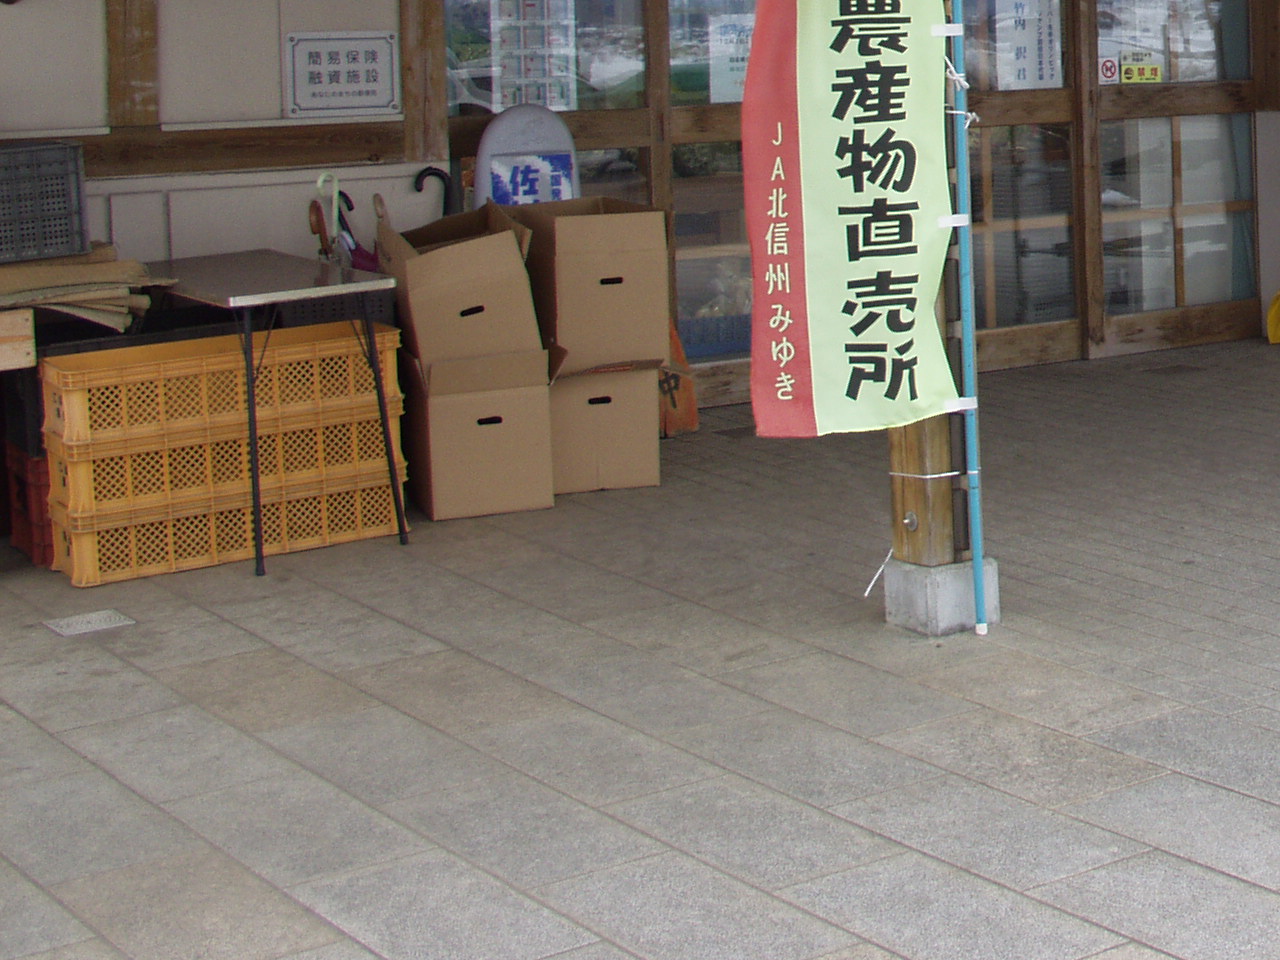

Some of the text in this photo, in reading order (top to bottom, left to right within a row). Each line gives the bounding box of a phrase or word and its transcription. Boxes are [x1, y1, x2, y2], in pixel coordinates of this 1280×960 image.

[308, 50, 379, 66] 簡易保険
[308, 69, 379, 85] 融資施設
[765, 123, 796, 401] JA北信州みゆき
